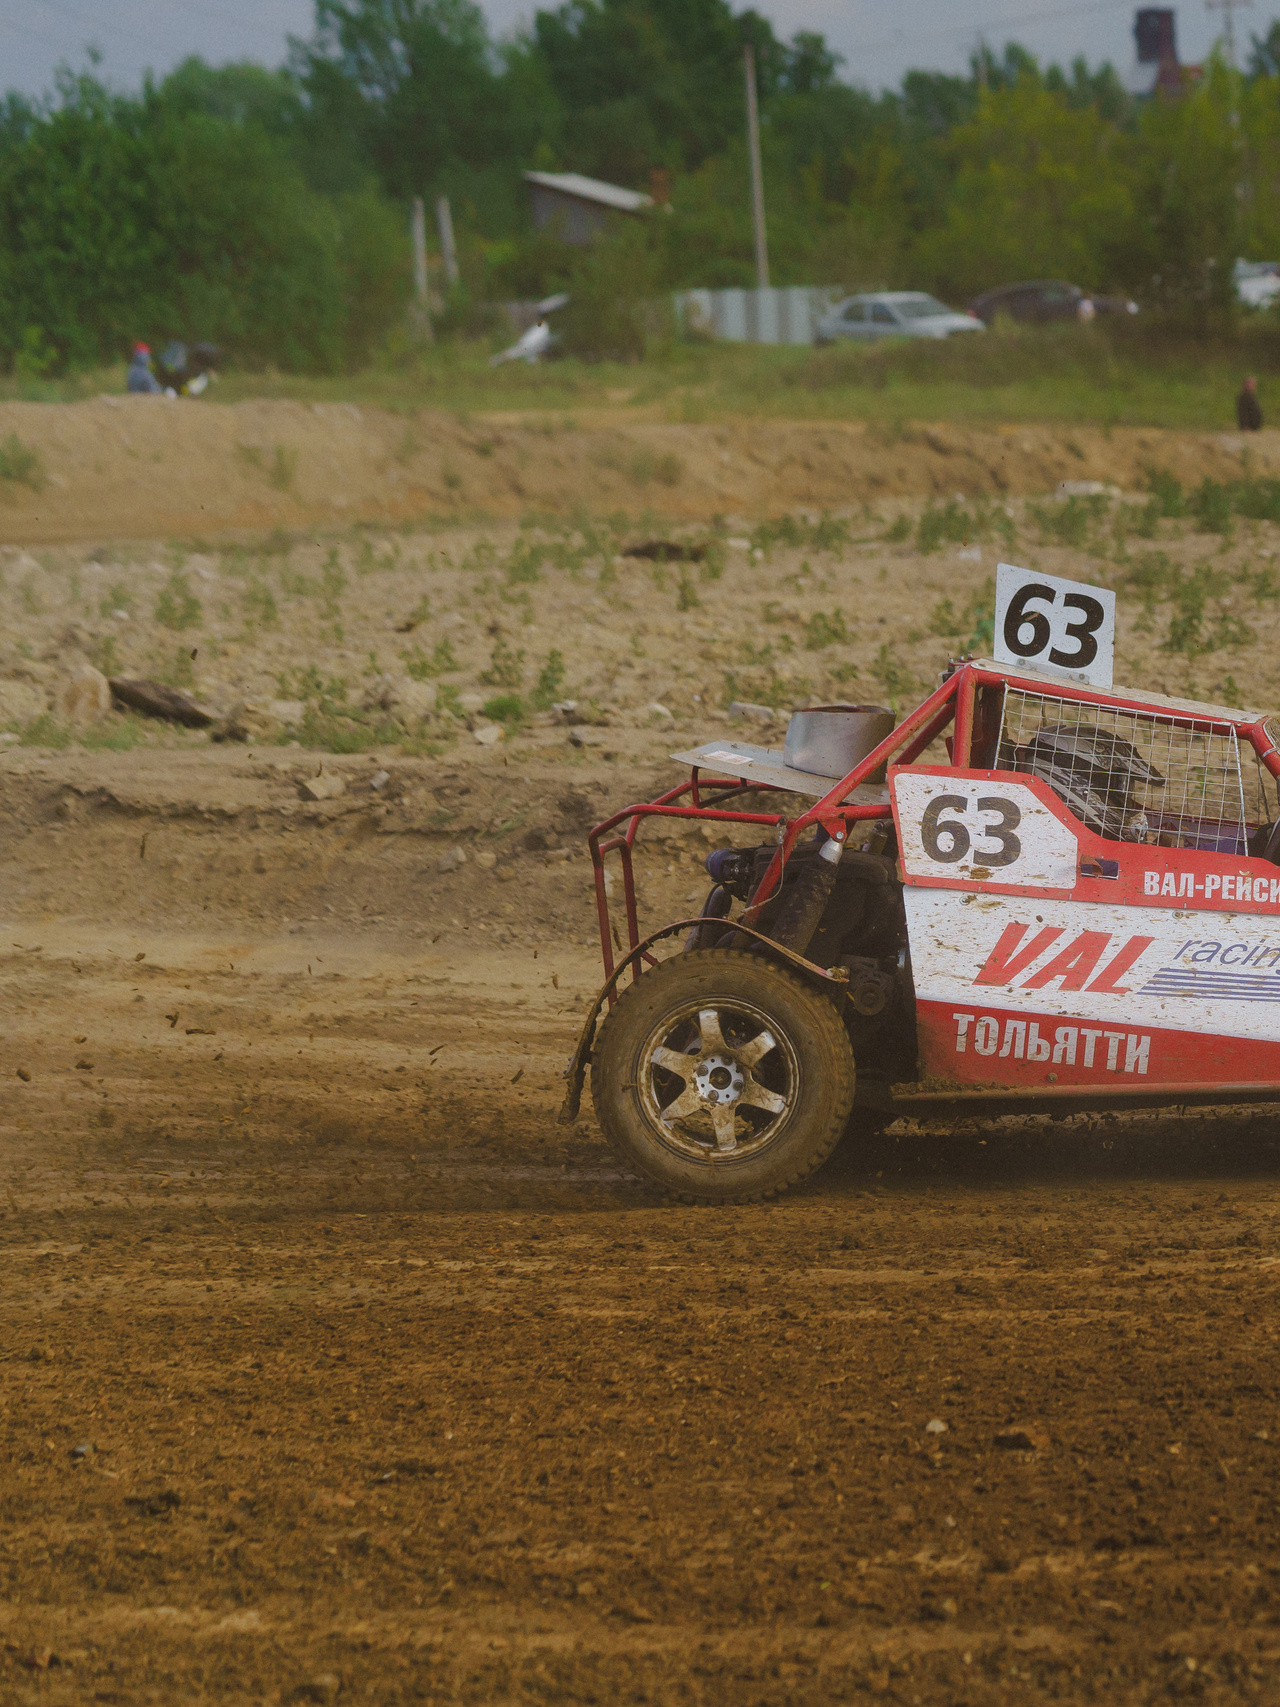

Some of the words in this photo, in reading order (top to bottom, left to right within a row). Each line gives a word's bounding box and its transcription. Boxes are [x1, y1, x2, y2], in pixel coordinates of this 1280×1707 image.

[1003, 583, 1105, 669] 63
[921, 794, 1022, 867] 63
[972, 922, 1155, 994] VAL
[953, 1013, 1151, 1074] ТОЛЬЯТТИ
